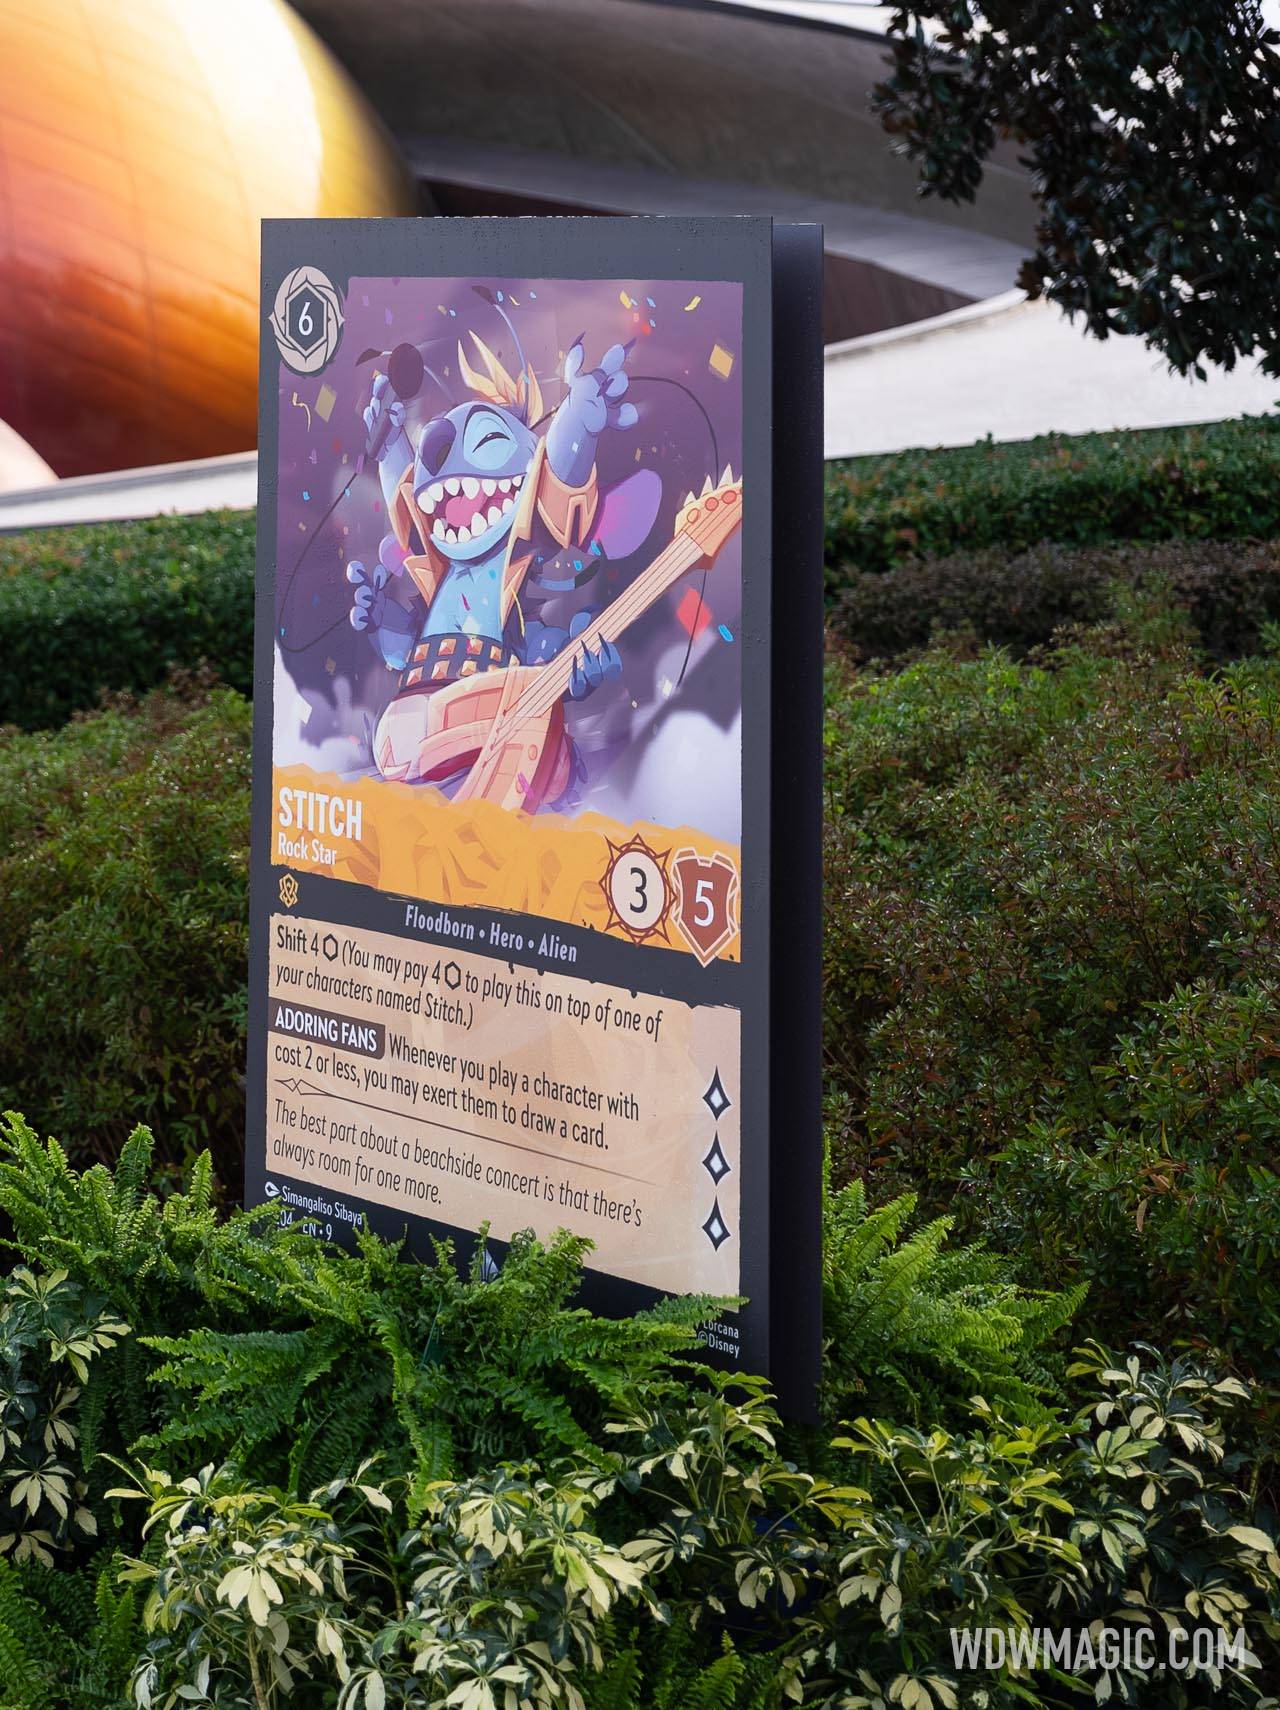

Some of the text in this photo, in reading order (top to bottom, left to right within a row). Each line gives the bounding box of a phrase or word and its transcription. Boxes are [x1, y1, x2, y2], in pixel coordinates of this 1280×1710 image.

[298, 301, 314, 336] 6
[279, 786, 362, 840] STITCH
[278, 832, 337, 865] Rock Star
[629, 866, 648, 913] 3
[694, 879, 714, 927] 5
[405, 904, 577, 962] Floodborn Hero Alien
[276, 965, 474, 1030] your characters named Stitch.)
[277, 924, 663, 1043] Shift 4 (You may pay 4 to play this on top of one of
[275, 1006, 639, 1121] ADORING FANS Whenever you play a character with
[275, 1045, 609, 1150] cost 2 or less, you may exert them to draw a card.
[273, 1133, 442, 1205] always room for one more.
[275, 1098, 642, 1227] The best part about a beachside concert is that there's
[282, 1185, 362, 1226] Simangaliso Sibaya
[325, 1223, 332, 1241] 9
[703, 1320, 739, 1339] Lorcana
